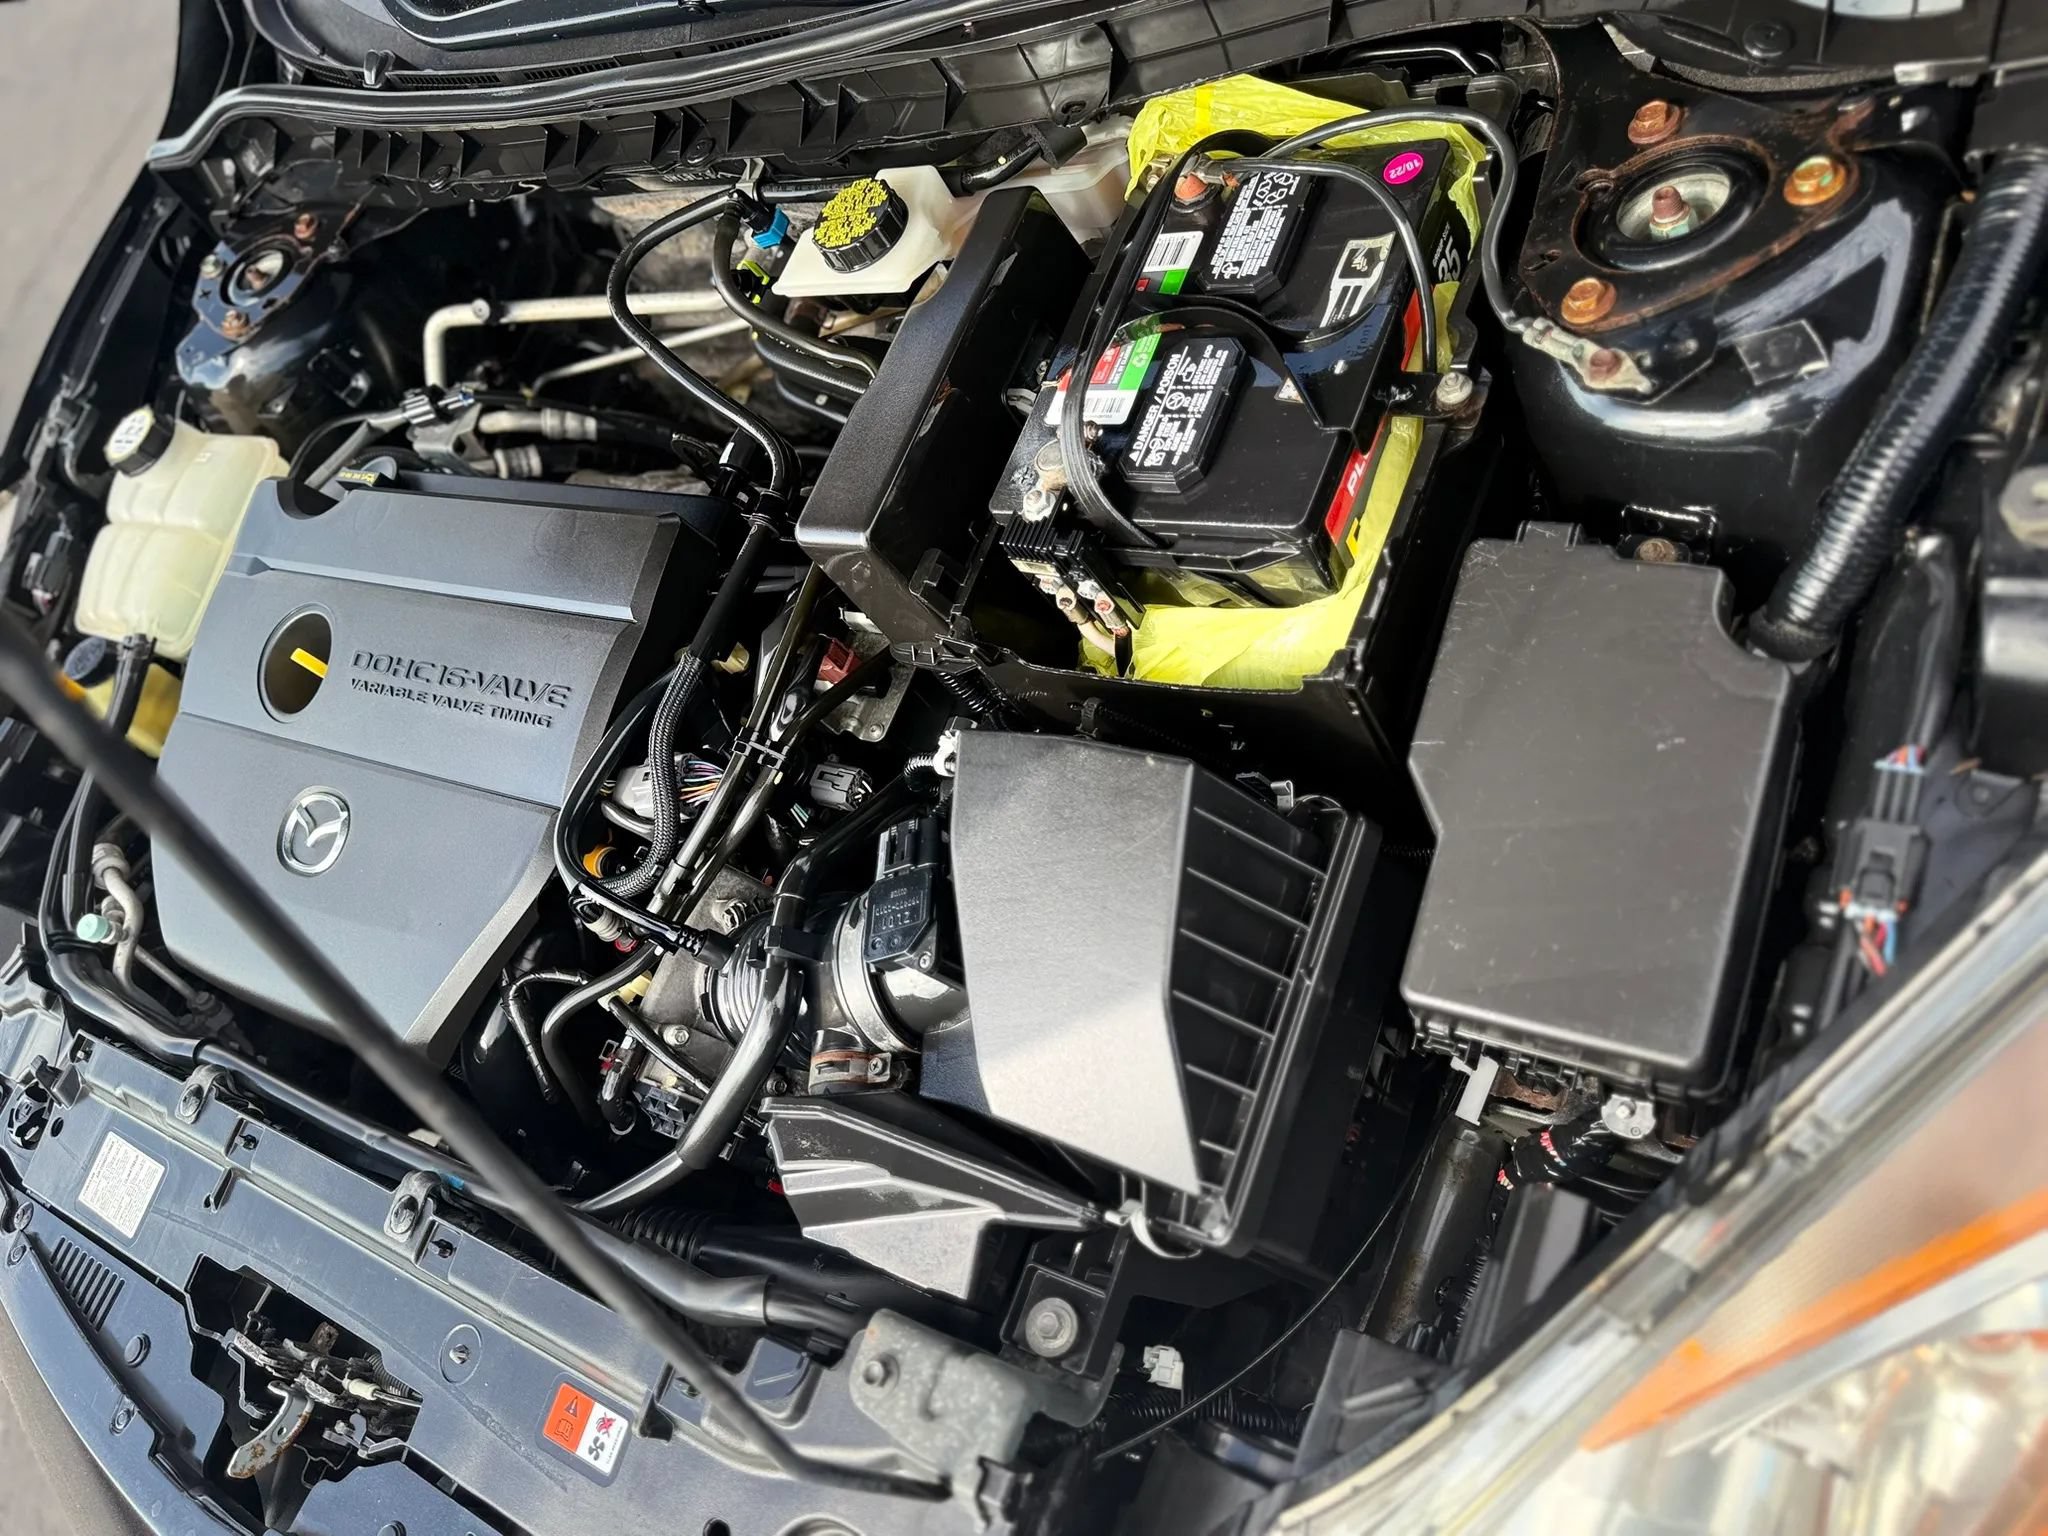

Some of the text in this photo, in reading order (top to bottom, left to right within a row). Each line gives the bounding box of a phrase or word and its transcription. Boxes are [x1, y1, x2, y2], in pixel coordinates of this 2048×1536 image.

[1389, 159, 1420, 179] 10/22
[1132, 404, 1160, 450] DANGER
[1156, 353, 1182, 395] POISON
[1347, 454, 1370, 497] PL
[351, 650, 572, 708] DOHC 16-VALVE
[351, 678, 553, 728] VARIABLE VALVE TIMING
